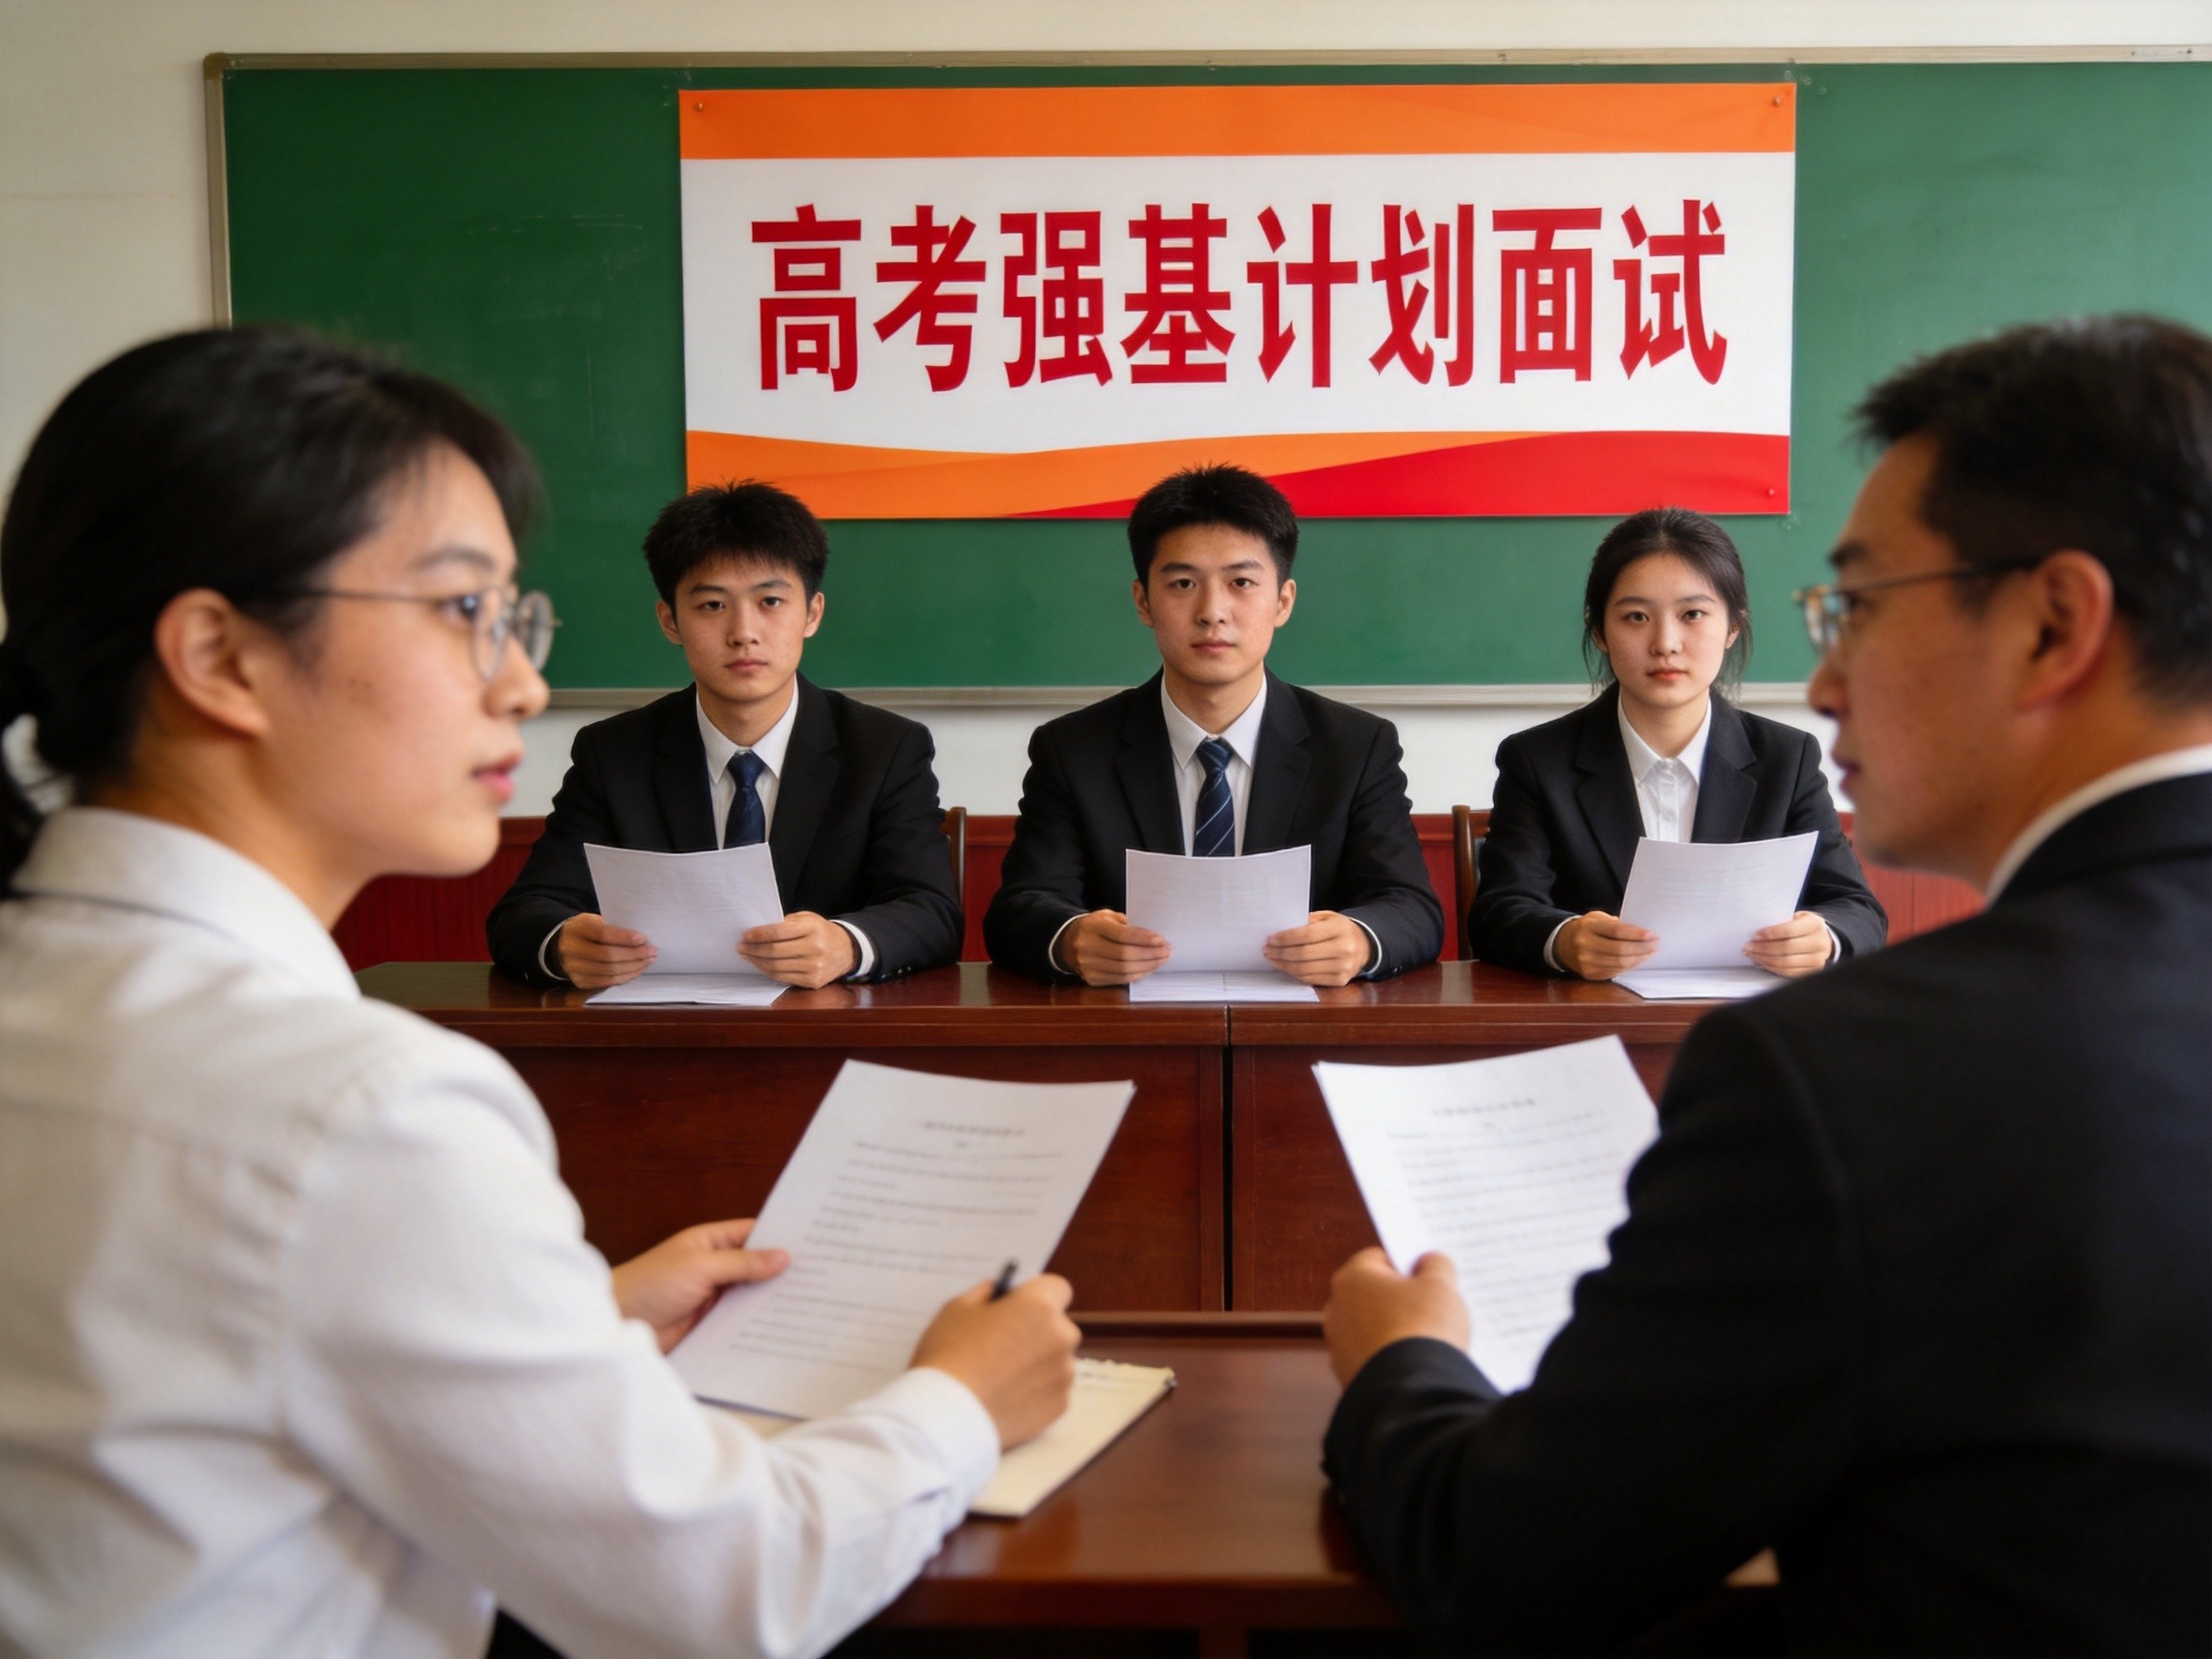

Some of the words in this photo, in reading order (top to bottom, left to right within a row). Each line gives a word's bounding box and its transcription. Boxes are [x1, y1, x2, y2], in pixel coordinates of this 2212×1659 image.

[752, 199, 1727, 393] 高考强基计划面试
